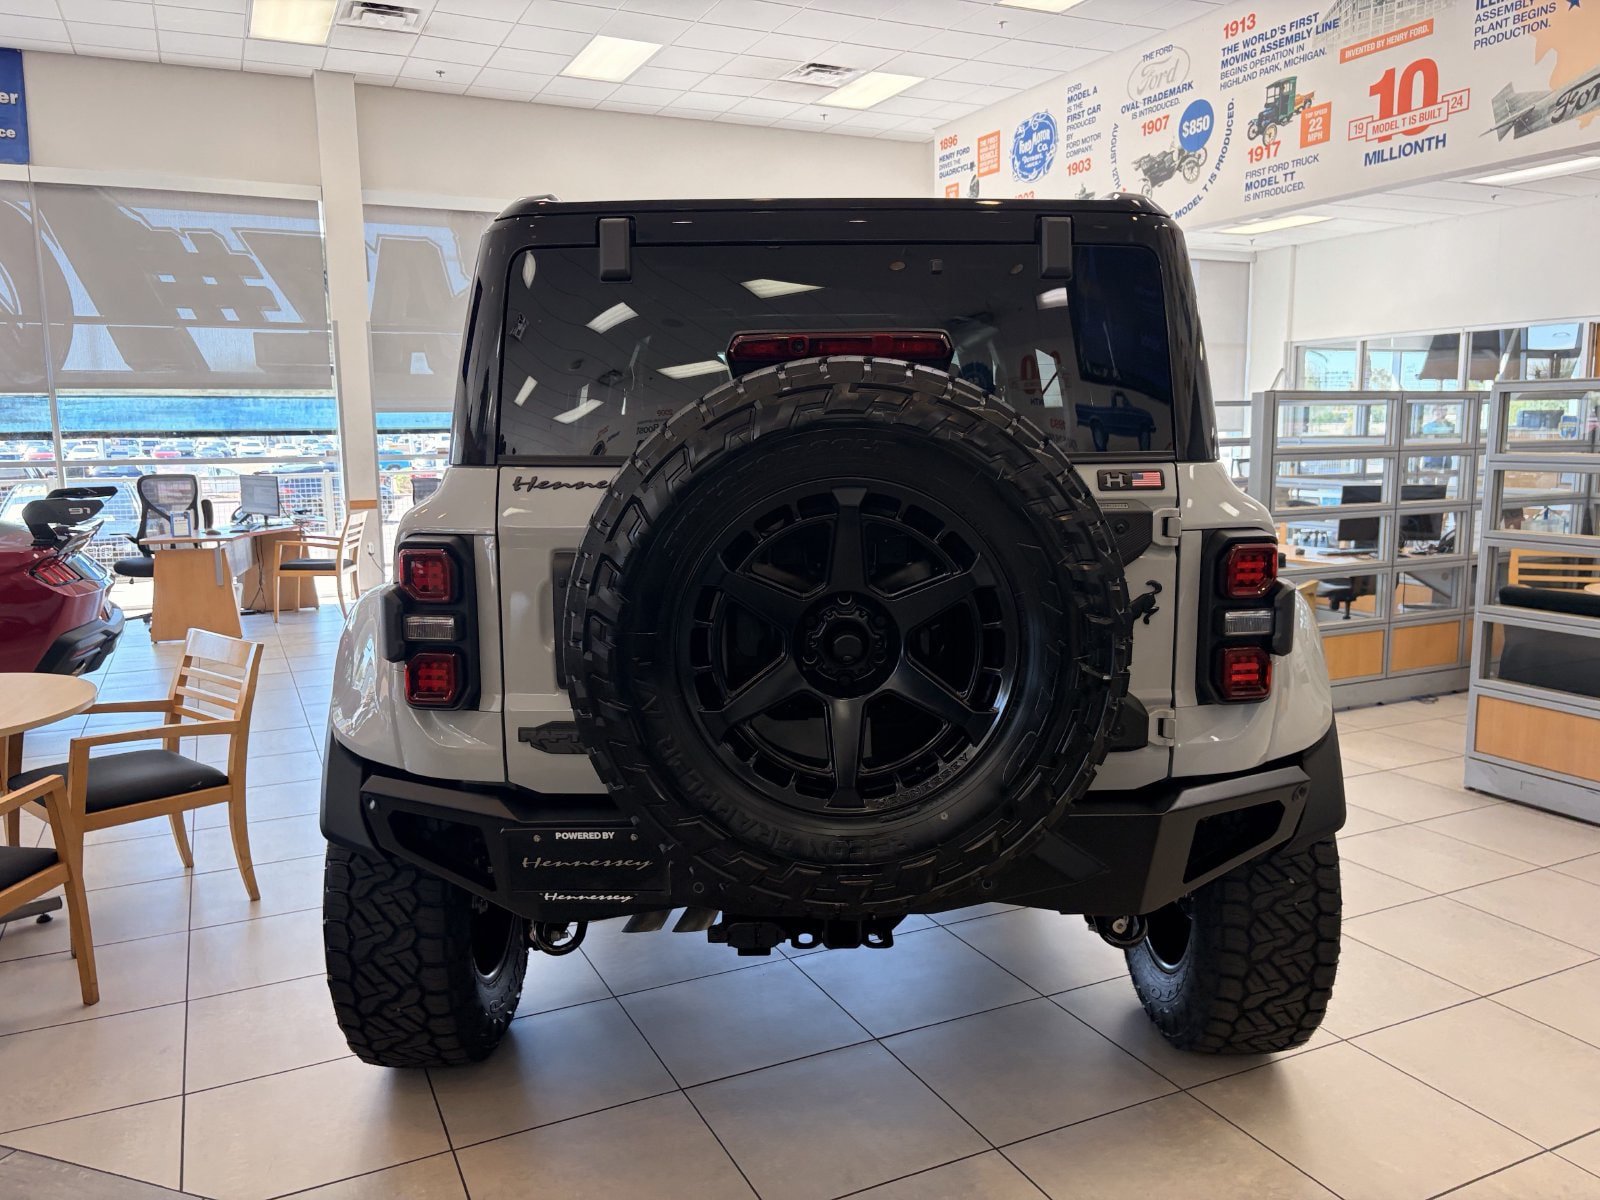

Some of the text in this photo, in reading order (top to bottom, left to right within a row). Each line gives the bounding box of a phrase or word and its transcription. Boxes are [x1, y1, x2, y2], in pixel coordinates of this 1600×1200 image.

[1474, 0, 1534, 25] ASSEMBLY
[1474, 2, 1557, 37] PLANT BEGINS
[1221, 12, 1320, 57] THE WORLD'S FIRST
[1223, 13, 1256, 39] 1913
[1473, 18, 1552, 50] PRODUCTION.
[1142, 44, 1174, 62] THE FORD
[1221, 17, 1341, 70] MOVING ASSEMBLY LINE
[1345, 43, 1376, 59] INVENTED
[1376, 38, 1386, 49] BY
[1386, 31, 1410, 46] HENRY
[1219, 47, 1328, 91] HIGHLAND PARK, MICHIGAN.
[1220, 43, 1305, 80] BEGINS OPERATION IN
[1137, 54, 1180, 95] Ford
[1067, 83, 1082, 94] FORD
[1067, 85, 1098, 104] MODEL A
[1120, 80, 1194, 114] OVAL TRADEMARK
[1369, 57, 1439, 143] 10
[1066, 104, 1101, 123] FIRST CAR
[1073, 101, 1083, 110] THE
[1131, 97, 1180, 120] IS INTRODUCED.
[1450, 95, 1464, 109] 24
[1066, 116, 1096, 132] PRODUCED
[1141, 115, 1170, 136] 1907
[1182, 114, 1210, 138] $850
[1309, 116, 1323, 132] 22
[1353, 122, 1364, 135] 19
[1372, 108, 1442, 135] MODEL T IS BUILT
[940, 134, 958, 150] 1896
[1066, 132, 1101, 150] FORD MOTOR
[1110, 123, 1119, 164] AUGUST
[1307, 130, 1323, 142] MPH
[1174, 98, 1235, 220] MODEL T IS PRODUCED.
[1247, 139, 1281, 164] 1917
[1364, 133, 1447, 167] MILLIONTH
[1066, 158, 1092, 176] 1903
[1245, 153, 1320, 180] FIRST FORD TRUCK
[1244, 171, 1296, 192] MODEL TT
[1244, 181, 1305, 203] IS INTRODUCED.
[555, 831, 615, 840] POWERED BY
[522, 857, 653, 870] Hennessey
[544, 892, 635, 902] Hennessey
